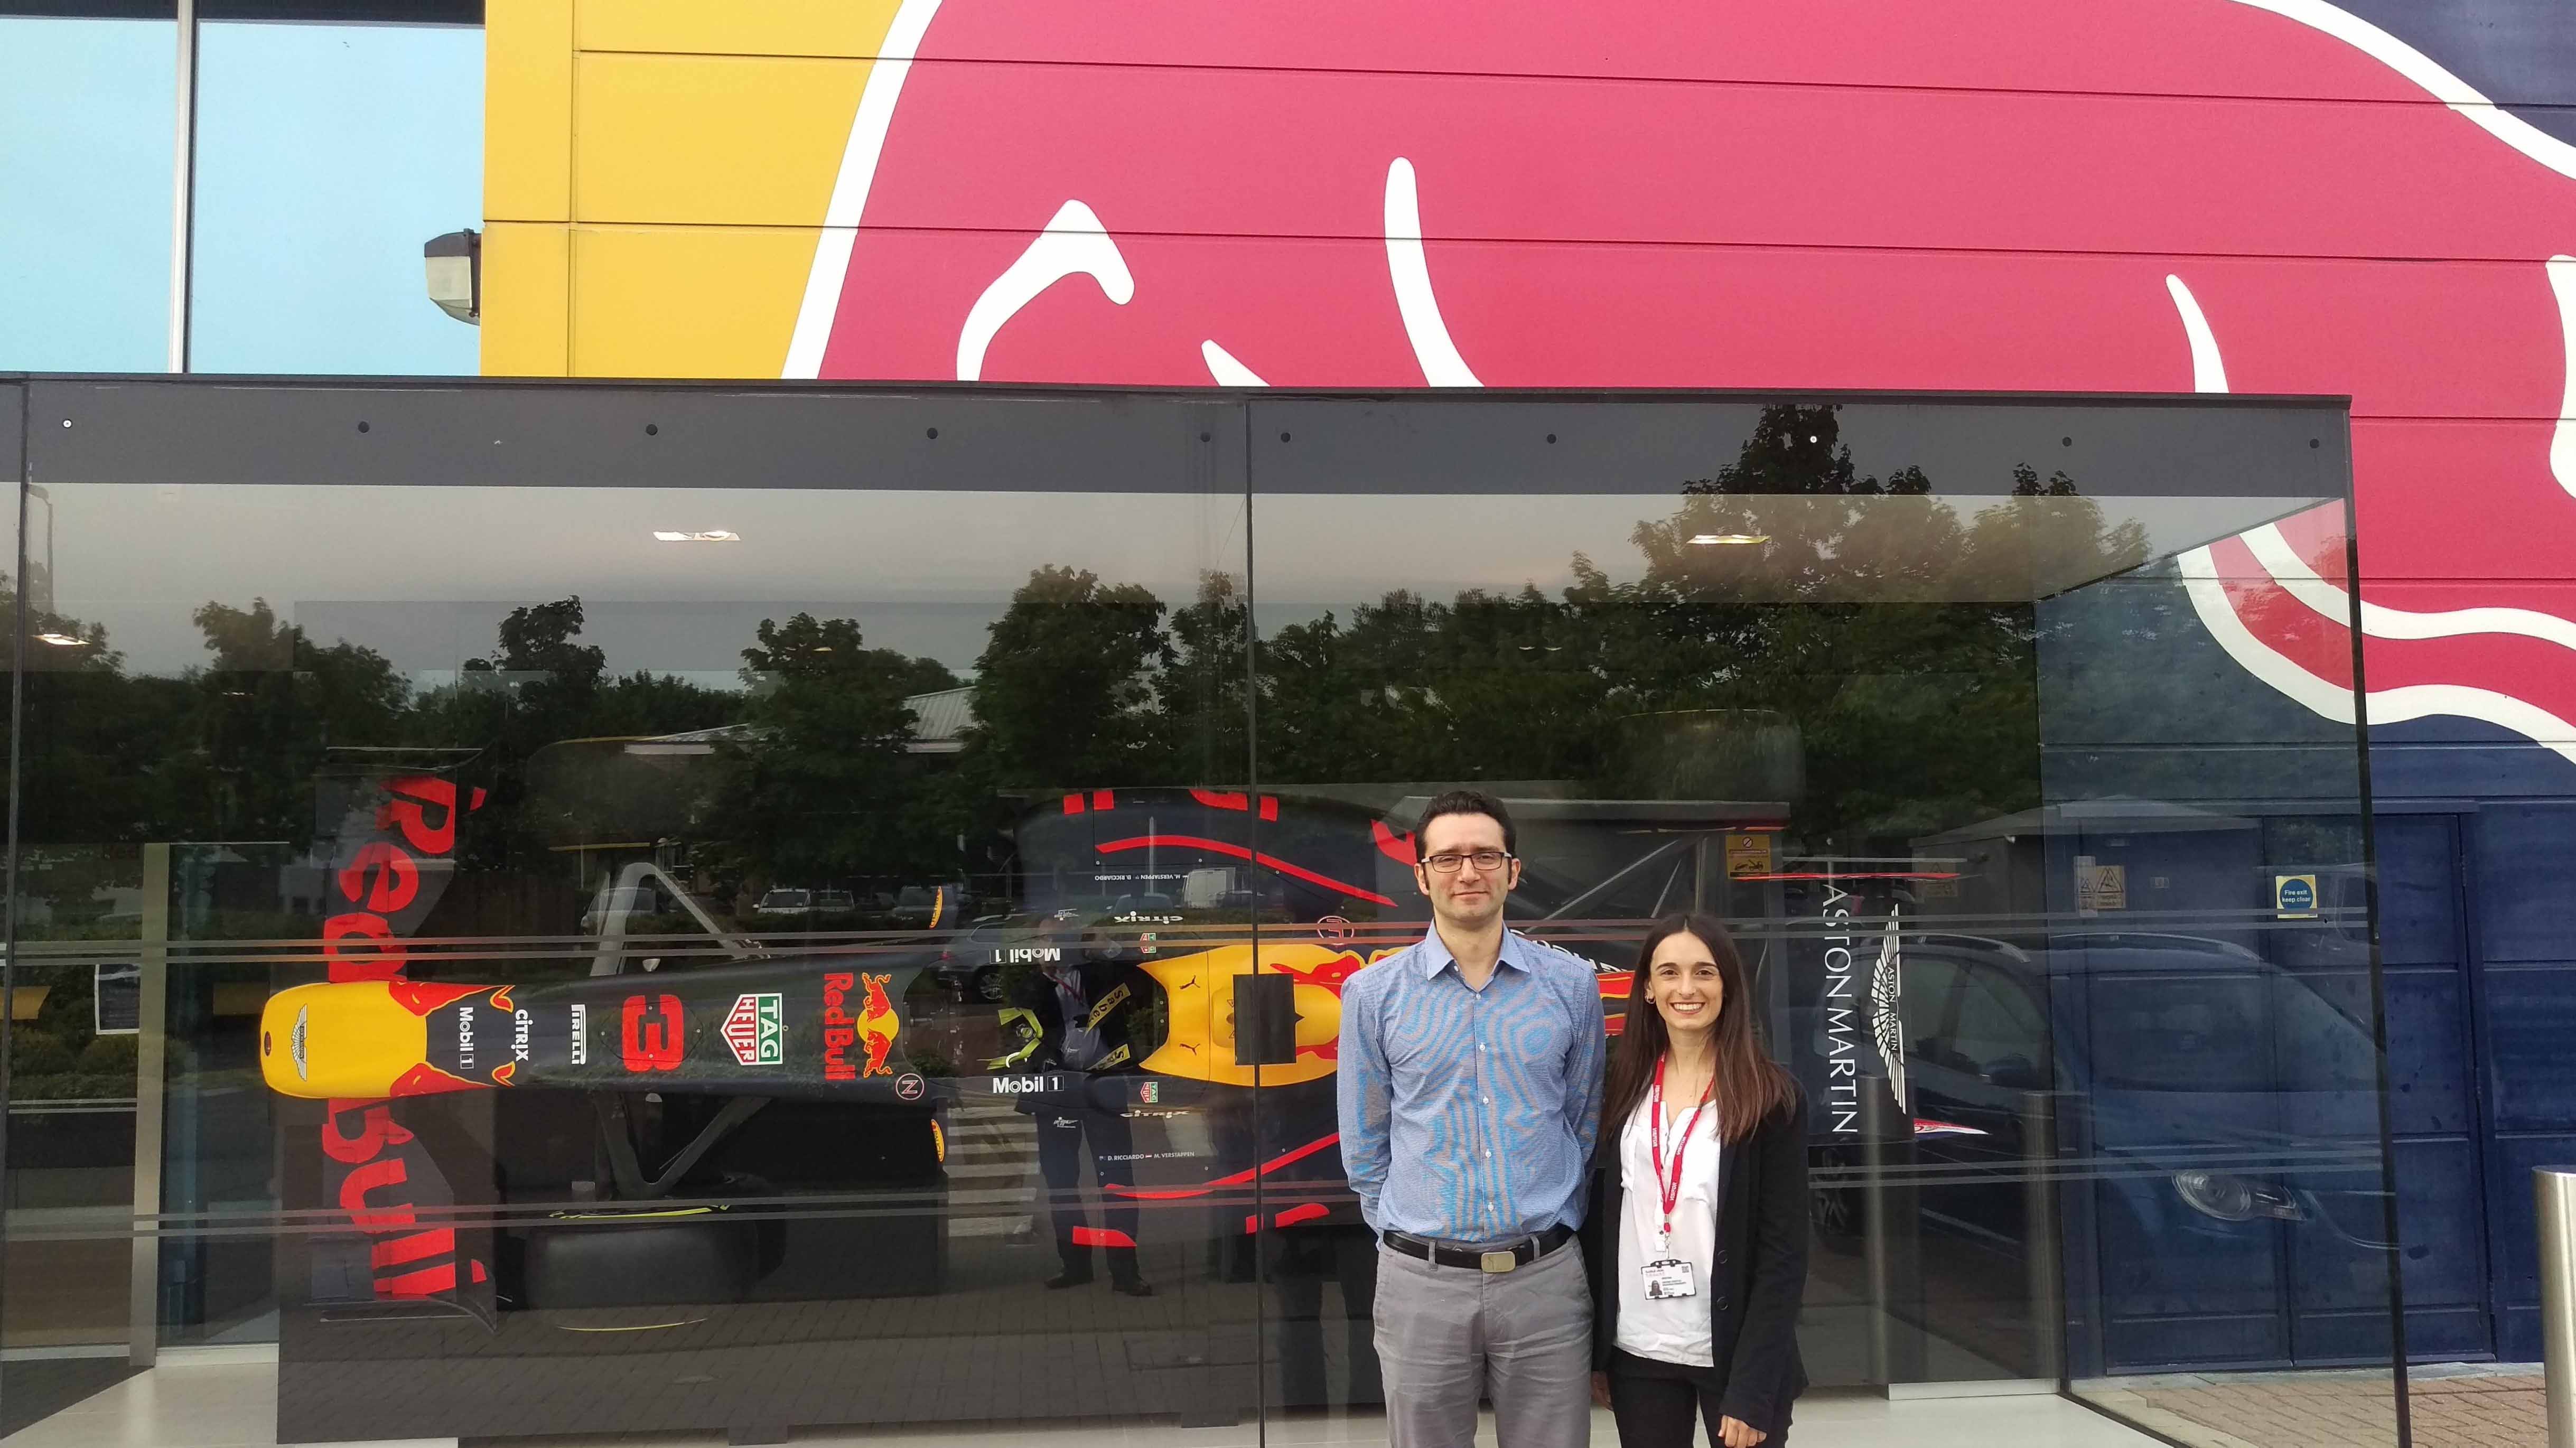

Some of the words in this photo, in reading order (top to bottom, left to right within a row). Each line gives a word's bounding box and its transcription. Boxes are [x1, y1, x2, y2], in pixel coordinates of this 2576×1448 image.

[1010, 948, 1060, 963] Mobil
[1822, 884, 1852, 999] ASTON
[823, 973, 854, 1026] Red
[459, 1007, 474, 1051] Mobil
[571, 1004, 586, 1065] PIRELLI
[622, 994, 684, 1071] 3
[728, 997, 755, 1062] HEUER
[760, 999, 779, 1060] TAG
[824, 1026, 856, 1080] Bull
[993, 1077, 1043, 1093] Mobil
[1826, 1007, 1858, 1133] MARTIN
[1677, 1136, 1686, 1155] VISITOR
